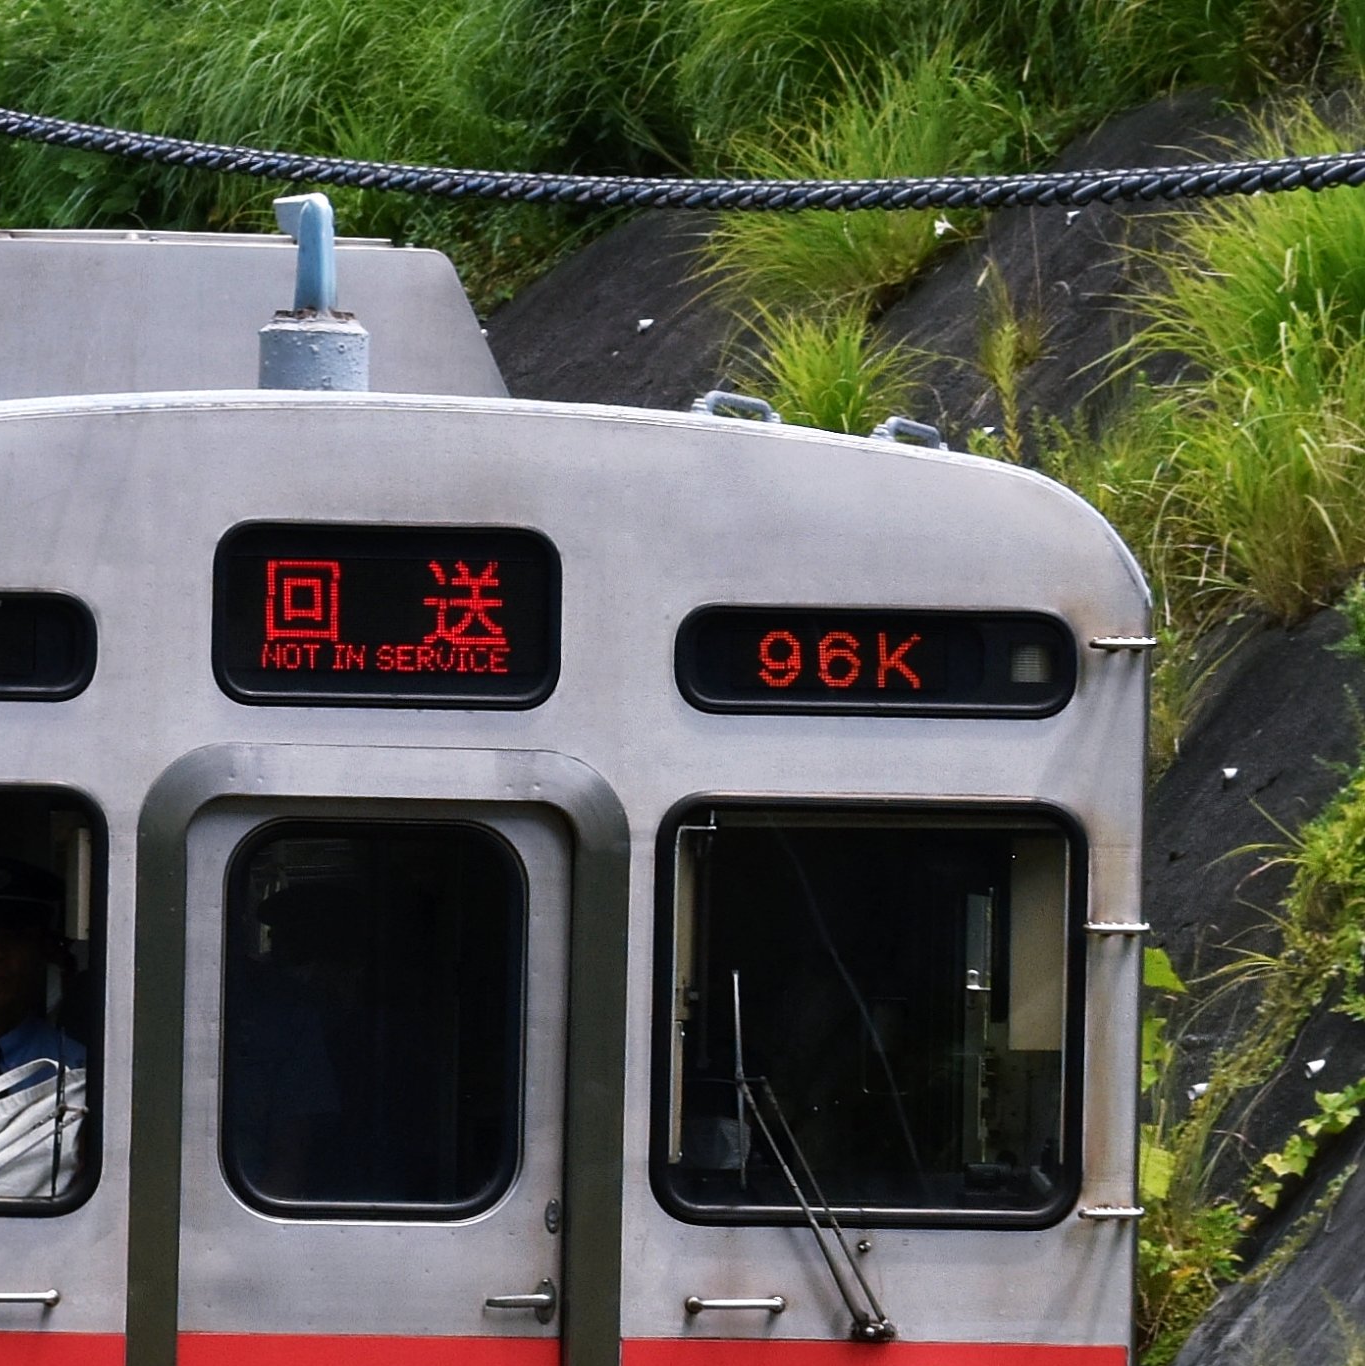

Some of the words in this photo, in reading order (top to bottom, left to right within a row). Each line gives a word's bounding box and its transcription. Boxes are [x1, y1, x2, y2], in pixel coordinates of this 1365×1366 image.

[266, 559, 508, 644] 回送
[261, 643, 321, 670] NOT
[332, 644, 366, 670] IN
[375, 645, 511, 673] SERVICE
[757, 629, 923, 690] 96K
